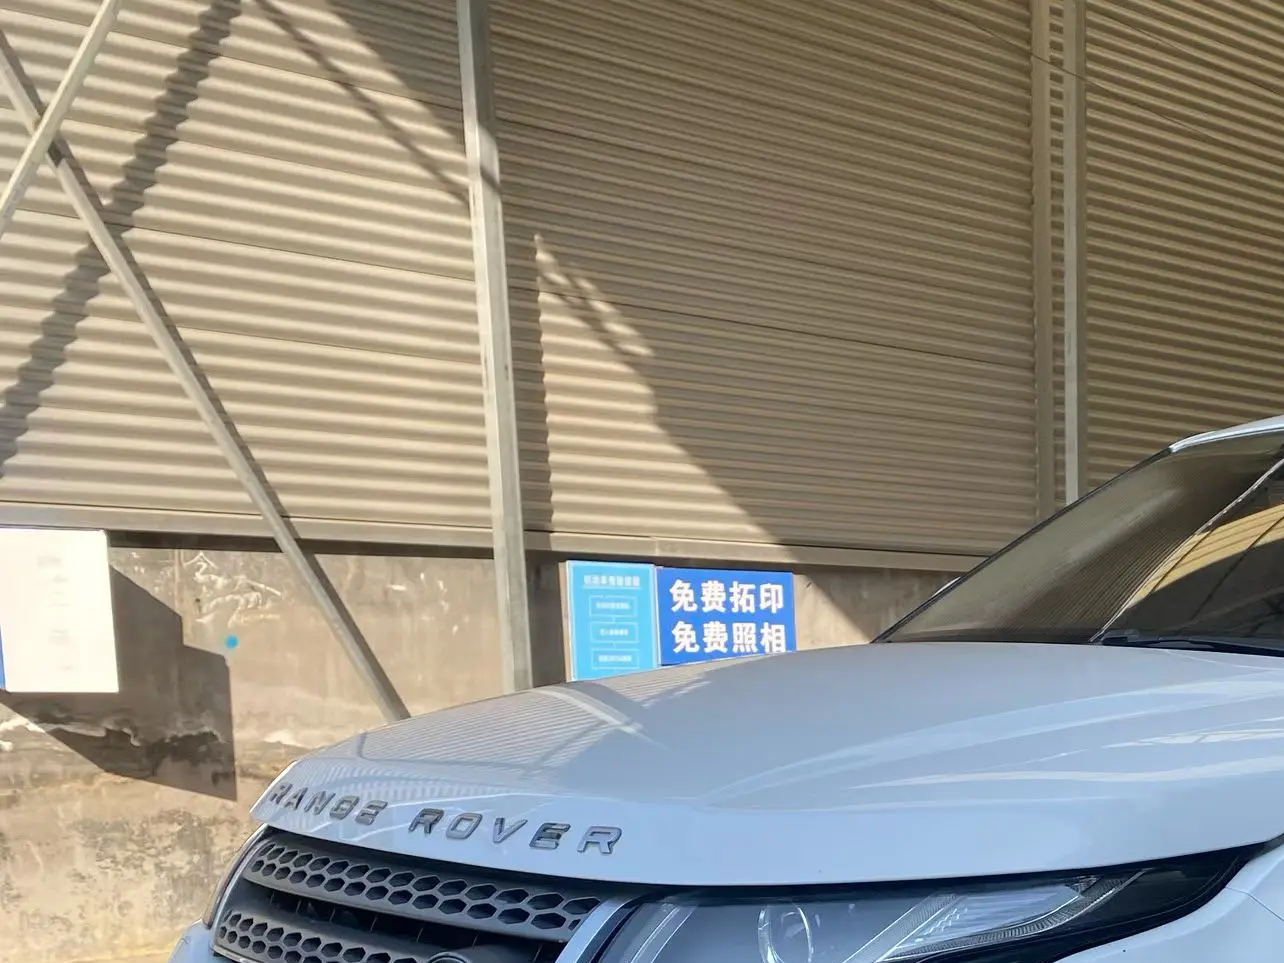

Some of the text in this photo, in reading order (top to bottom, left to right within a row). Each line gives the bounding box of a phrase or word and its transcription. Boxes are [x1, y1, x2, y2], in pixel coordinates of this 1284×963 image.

[669, 579, 784, 614] 免费拓印
[671, 620, 786, 653] 免费照相
[269, 782, 623, 855] RANGE ROVER
